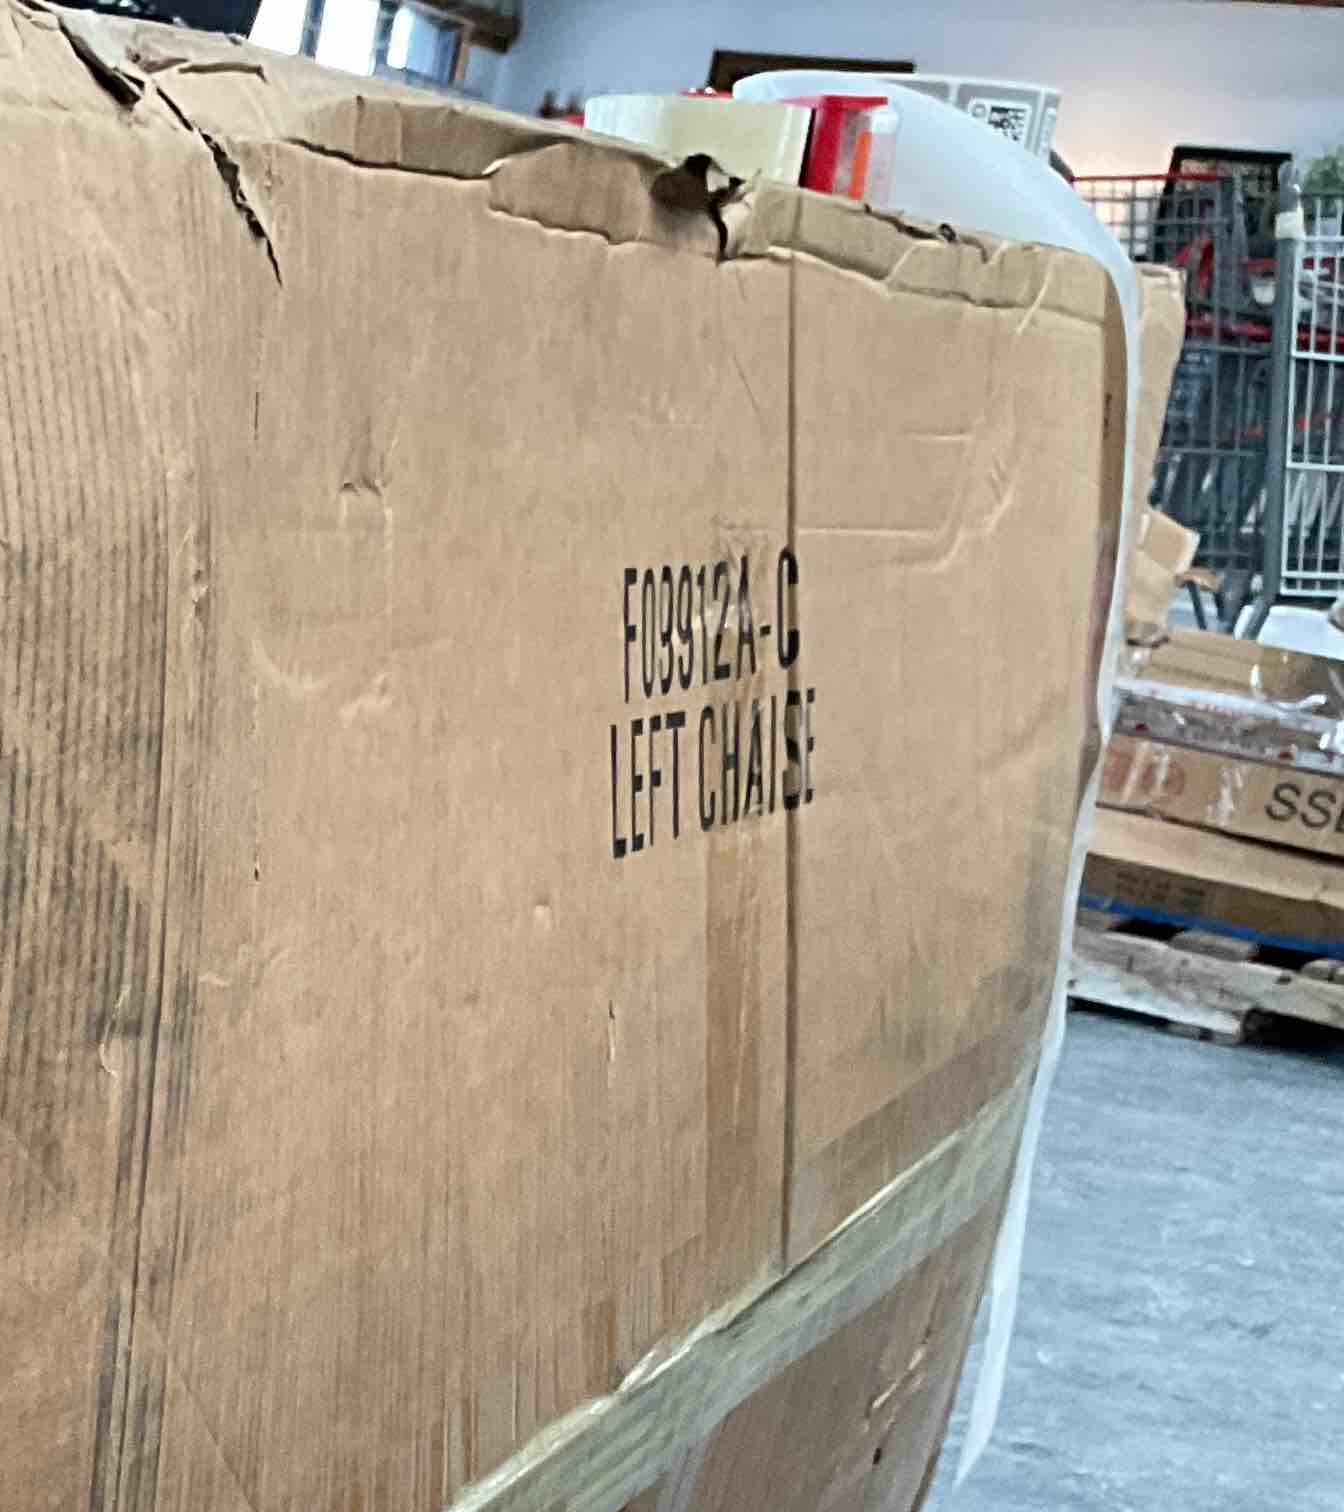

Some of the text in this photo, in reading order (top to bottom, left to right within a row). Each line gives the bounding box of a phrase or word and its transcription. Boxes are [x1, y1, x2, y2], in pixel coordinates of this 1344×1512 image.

[624, 547, 799, 703] F09912A-C
[610, 687, 815, 858] LEFT CHAISE
